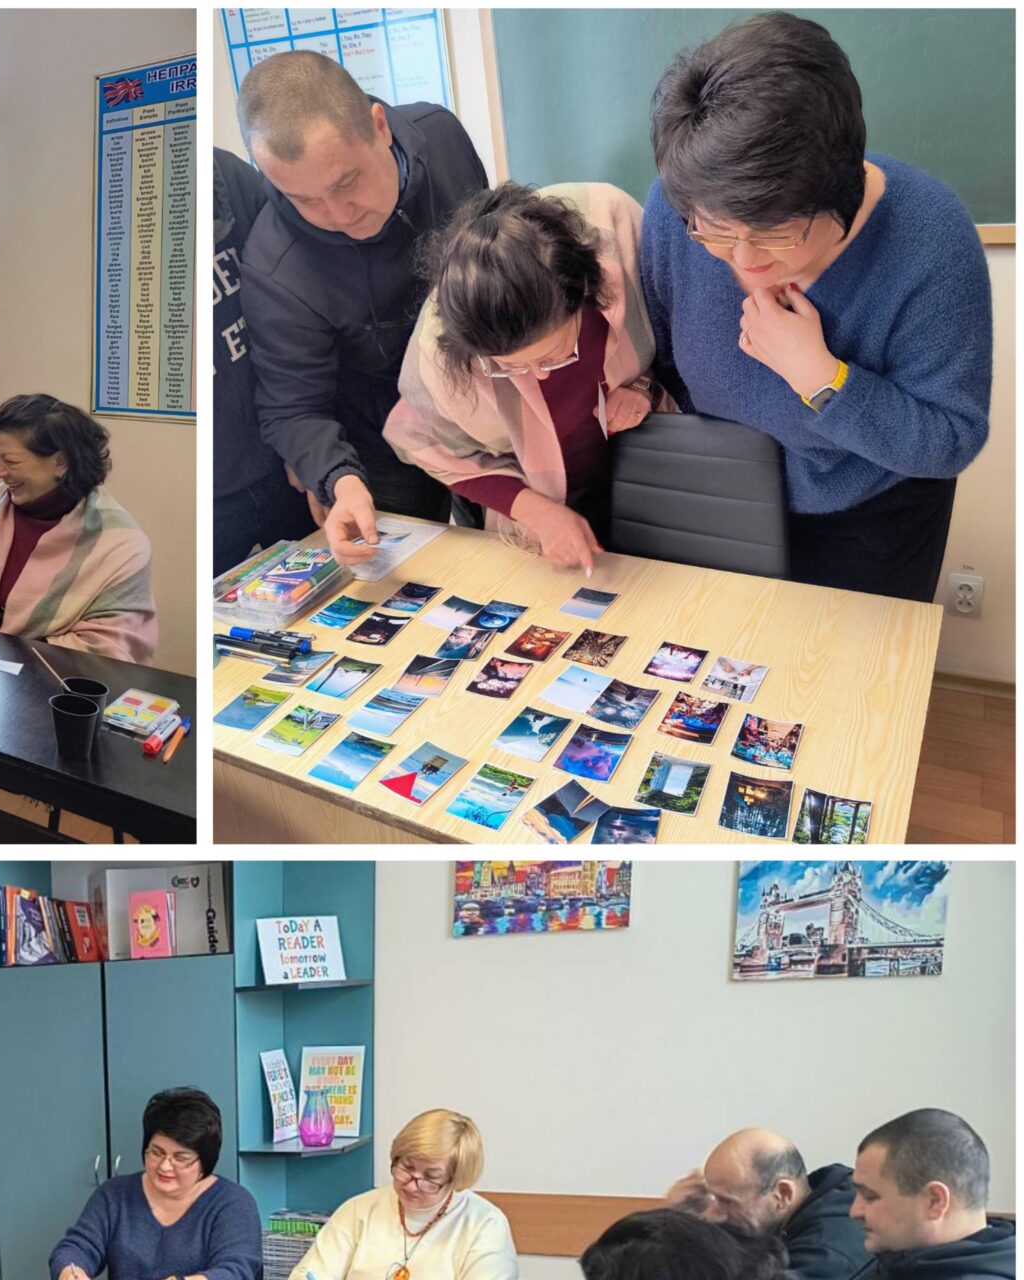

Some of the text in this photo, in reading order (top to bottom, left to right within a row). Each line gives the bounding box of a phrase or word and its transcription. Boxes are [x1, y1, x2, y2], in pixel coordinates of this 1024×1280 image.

[206, 908, 218, 954] Guide
[313, 919, 322, 932] A
[278, 935, 325, 951] READER
[280, 953, 326, 965] tomorrow
[283, 966, 329, 979] a LEADER
[337, 1056, 353, 1065] DAY
